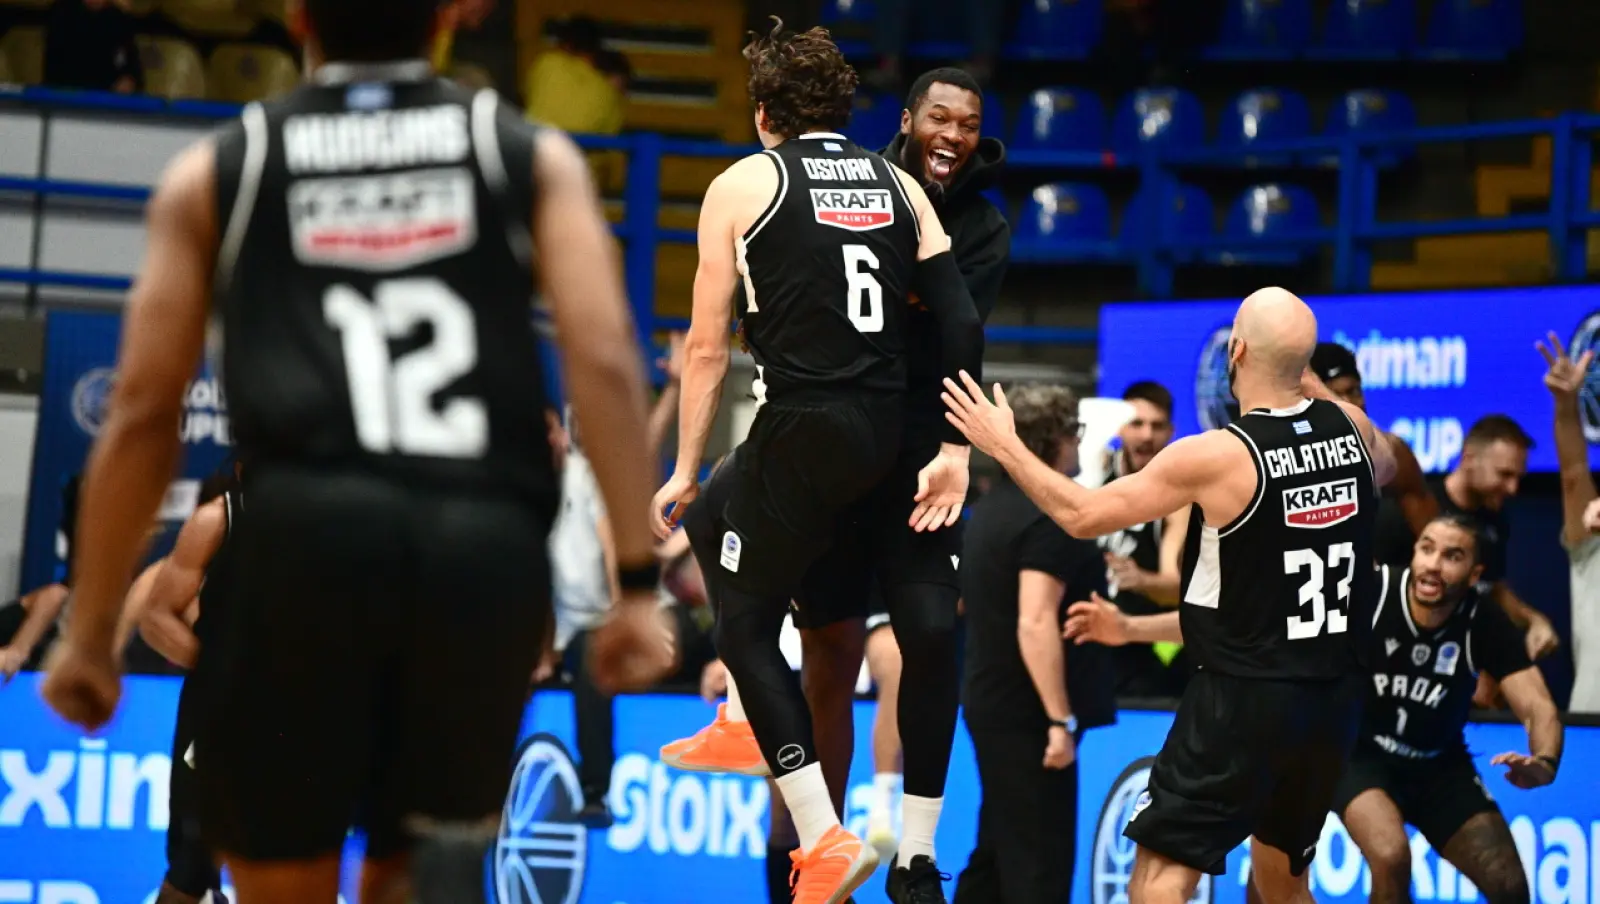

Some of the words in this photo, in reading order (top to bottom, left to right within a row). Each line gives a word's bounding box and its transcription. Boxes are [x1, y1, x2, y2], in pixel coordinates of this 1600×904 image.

[801, 157, 877, 181] OSMAN
[813, 191, 889, 209] KRAFT
[836, 213, 874, 223] PAINTS
[841, 244, 884, 333] 6
[322, 276, 489, 457] 12
[1264, 434, 1362, 479] CALATHES
[1286, 481, 1356, 511] KRAFT
[1306, 508, 1342, 522] PAINTS
[1283, 541, 1356, 640] 33
[1373, 673, 1448, 709] PAOK
[1396, 705, 1408, 736] 1
